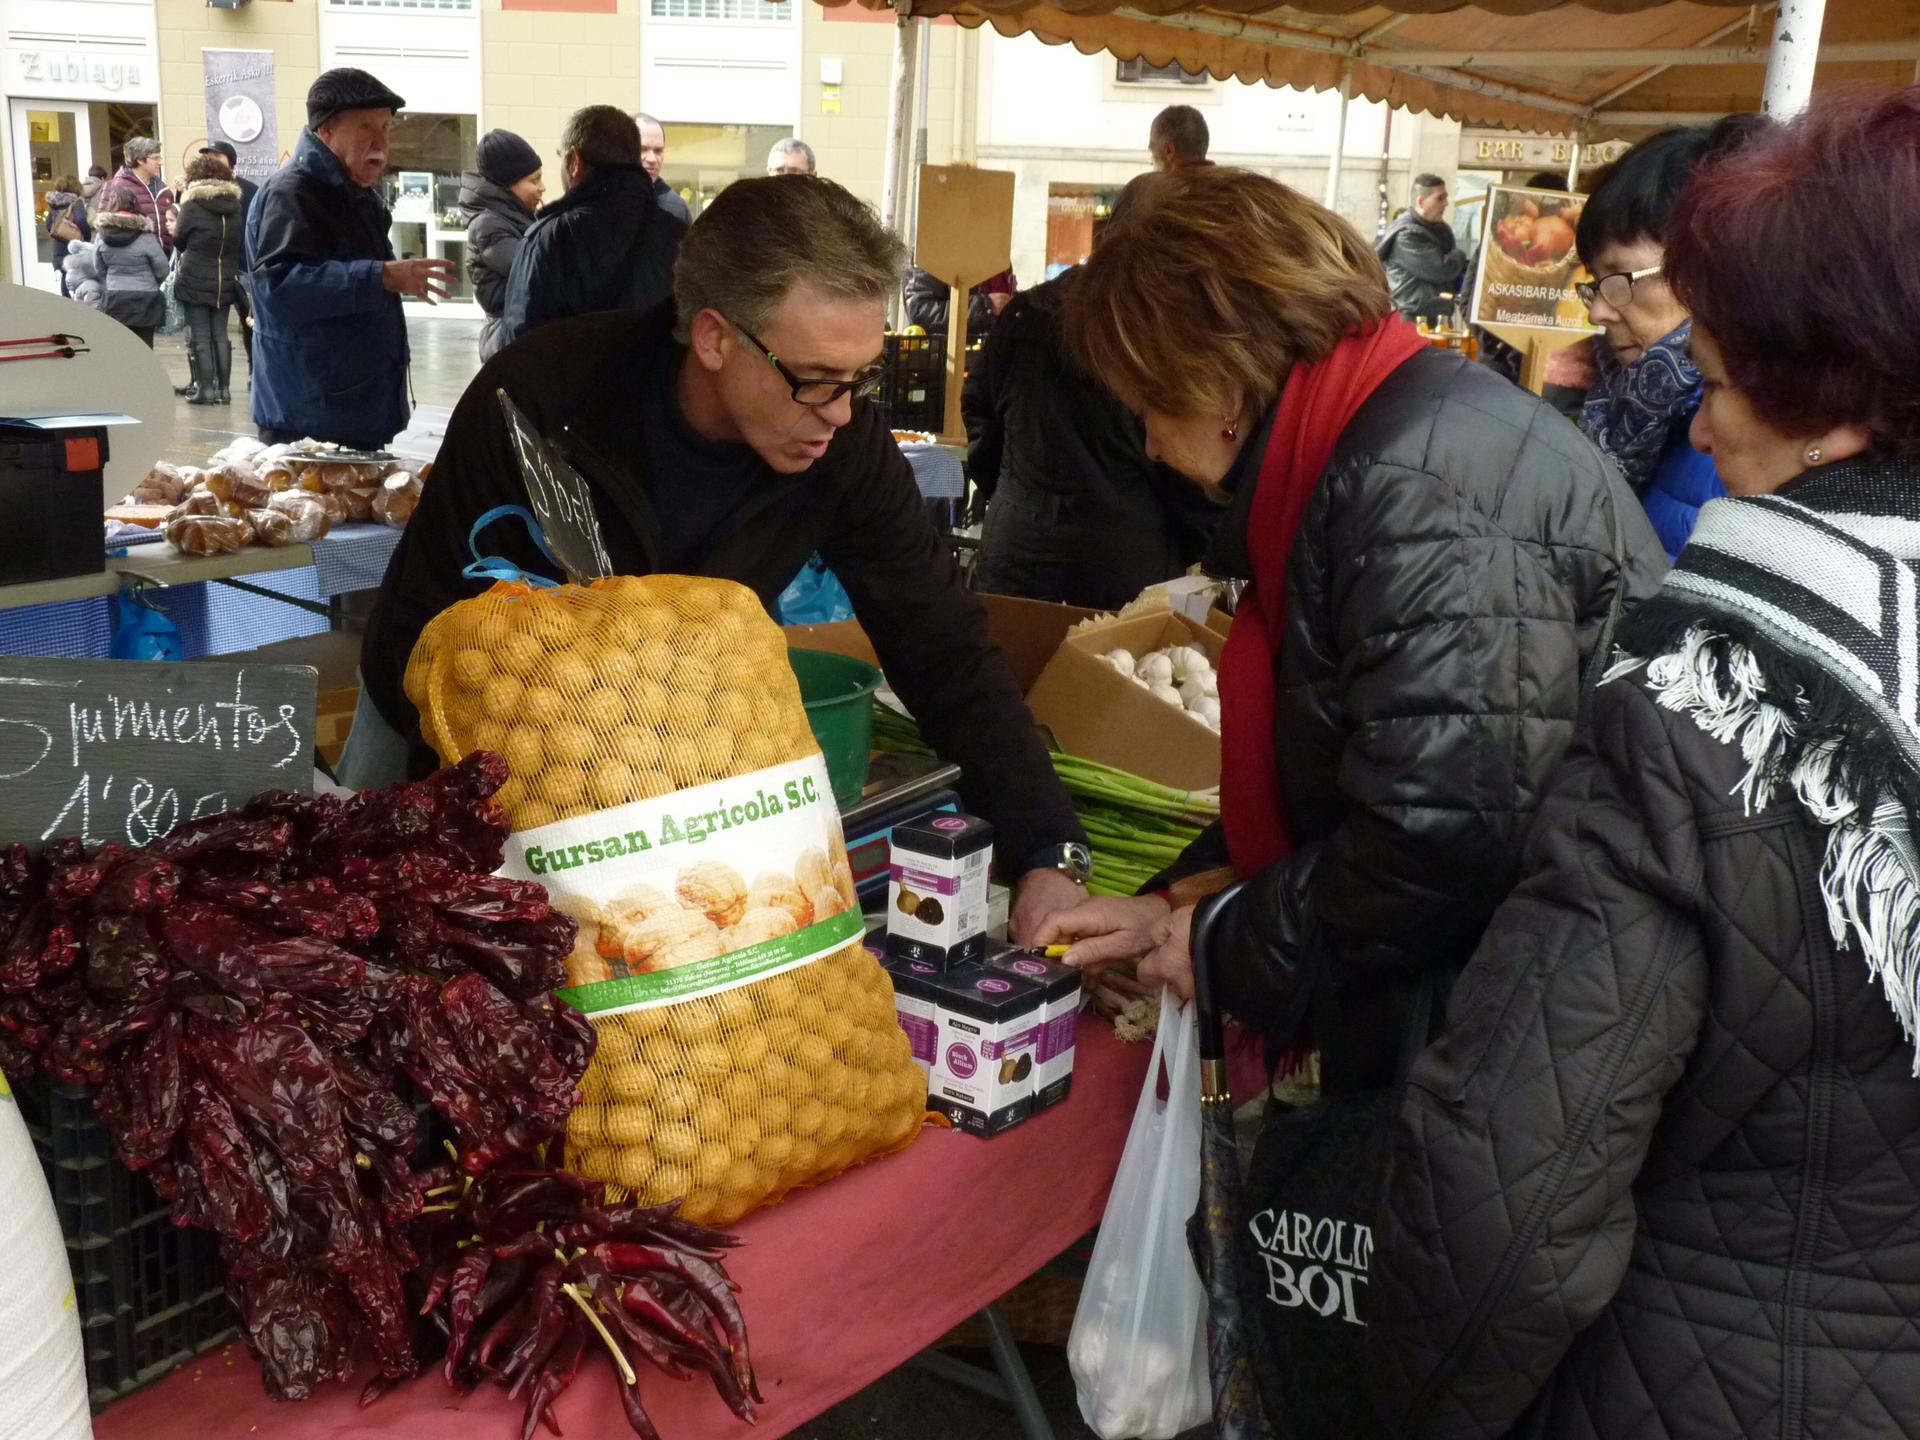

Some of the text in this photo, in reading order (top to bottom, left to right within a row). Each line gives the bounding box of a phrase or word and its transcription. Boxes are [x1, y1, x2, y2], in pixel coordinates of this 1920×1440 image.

[19, 53, 141, 92] Zubiaga
[205, 69, 238, 88] Eskerrik
[242, 65, 261, 80] Asko
[1477, 141, 1524, 160] BAR
[248, 155, 257, 165] 55
[1487, 282, 1547, 299] ASKASIBAR
[525, 774, 820, 876] Gursan Agrícola S.C.
[951, 1050, 968, 1061] Black
[953, 1058, 974, 1070] Allium
